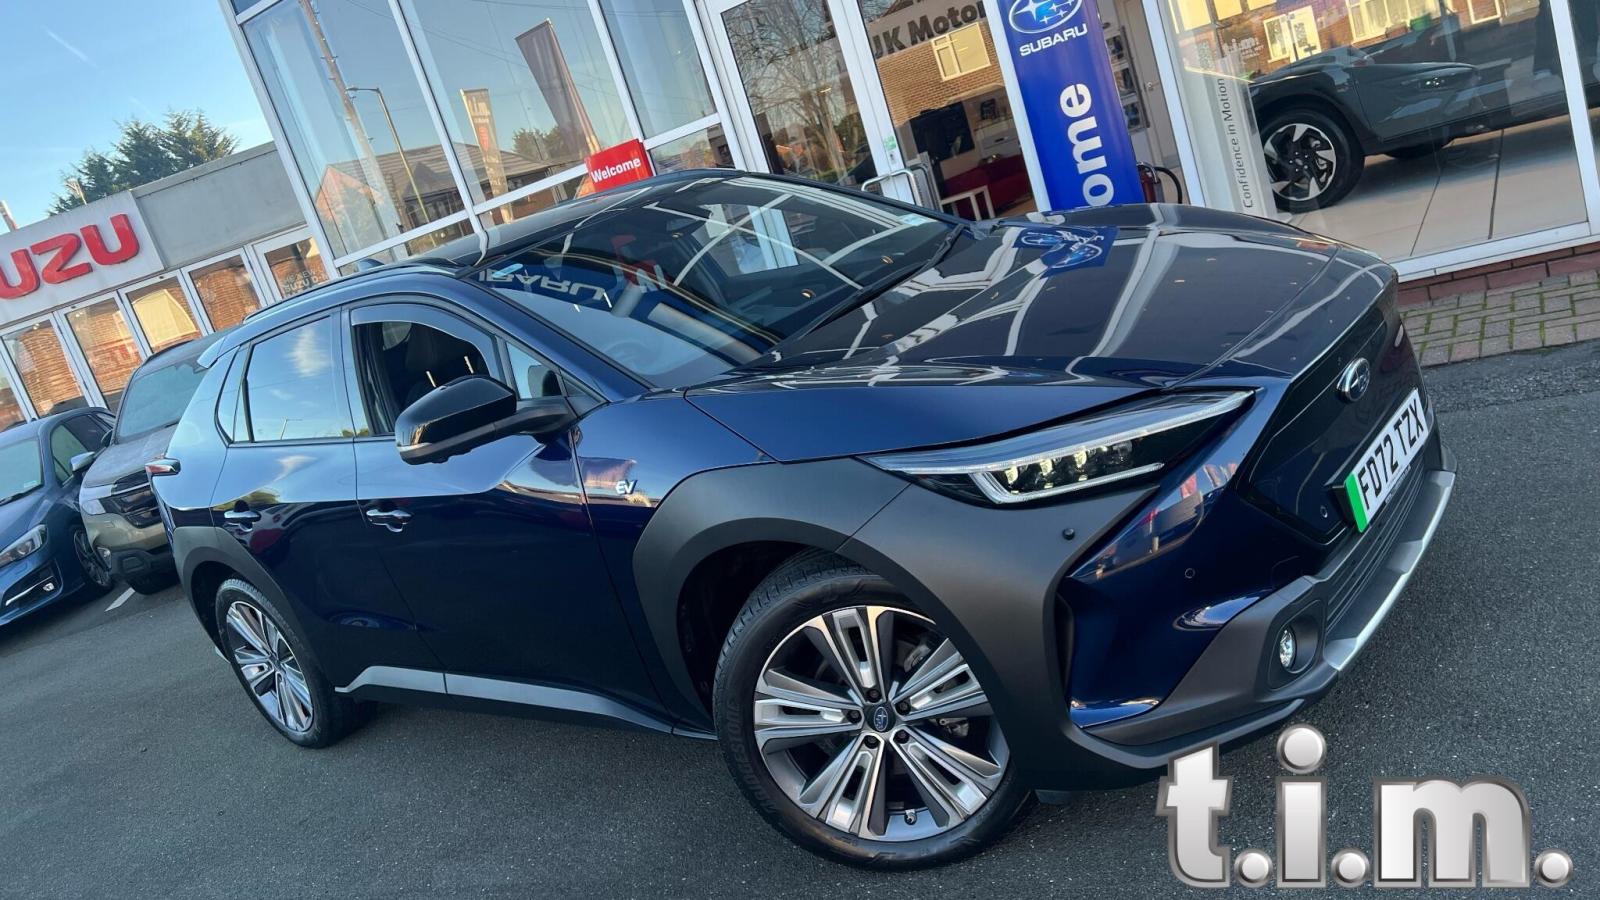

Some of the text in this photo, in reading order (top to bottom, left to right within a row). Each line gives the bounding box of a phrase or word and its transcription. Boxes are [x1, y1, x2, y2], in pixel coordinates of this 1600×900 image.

[1020, 23, 1088, 57] SUBARU
[591, 158, 641, 183] Welcome
[1060, 83, 1115, 206] ome
[1217, 78, 1253, 208] Confidence in Motion
[615, 479, 638, 495] EV
[1357, 434, 1398, 510] FD72
[1394, 398, 1424, 455] TZX
